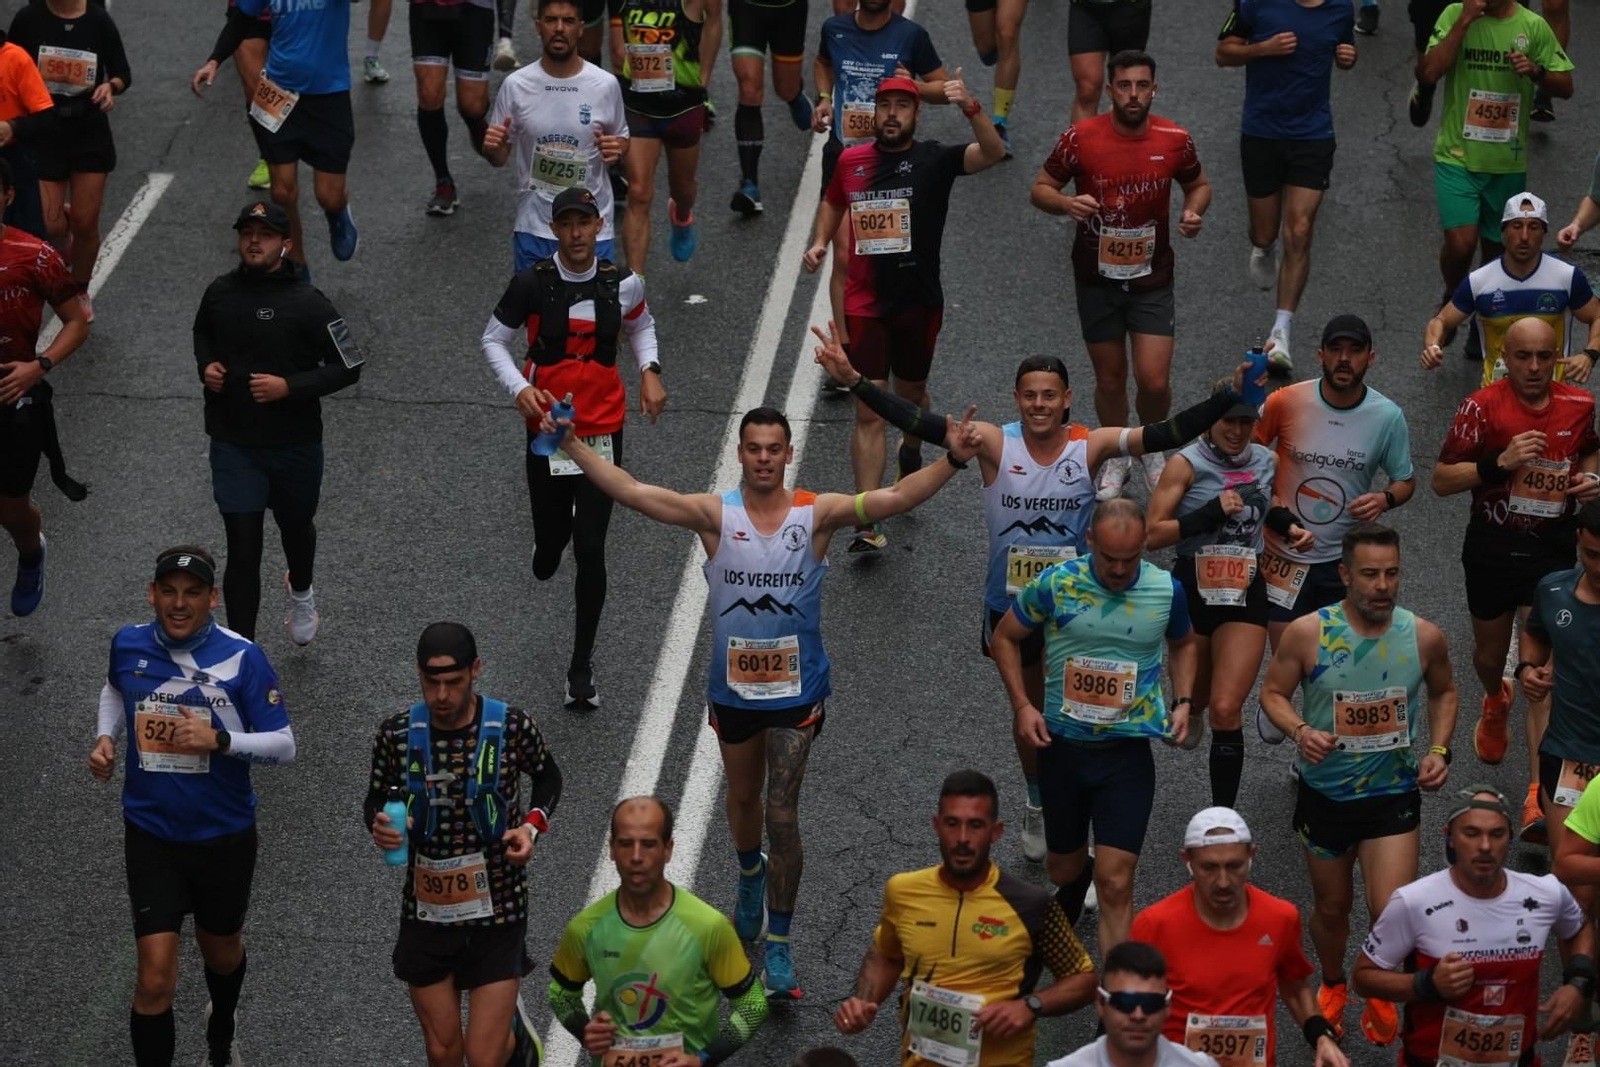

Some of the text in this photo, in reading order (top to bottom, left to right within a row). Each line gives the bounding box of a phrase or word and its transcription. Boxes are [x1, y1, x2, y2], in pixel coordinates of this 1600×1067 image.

[257, 83, 284, 107] 3937
[1475, 104, 1508, 121] 4534
[540, 159, 574, 179] 6725
[860, 213, 894, 231] 6021
[1107, 241, 1144, 257] 4215
[1523, 471, 1566, 492] 4838
[1002, 494, 1082, 511] LOS VEREITAS
[725, 569, 805, 588] LOS VEREITAS
[1206, 560, 1245, 579] 5702
[739, 653, 782, 672] 6012
[1073, 672, 1118, 697] 3986
[1345, 704, 1390, 725] 3983
[144, 719, 177, 742] 527
[423, 873, 468, 894] 3978
[918, 1002, 962, 1034] 7486
[1199, 1033, 1249, 1056] 3597
[1454, 1027, 1505, 1052] 4582
